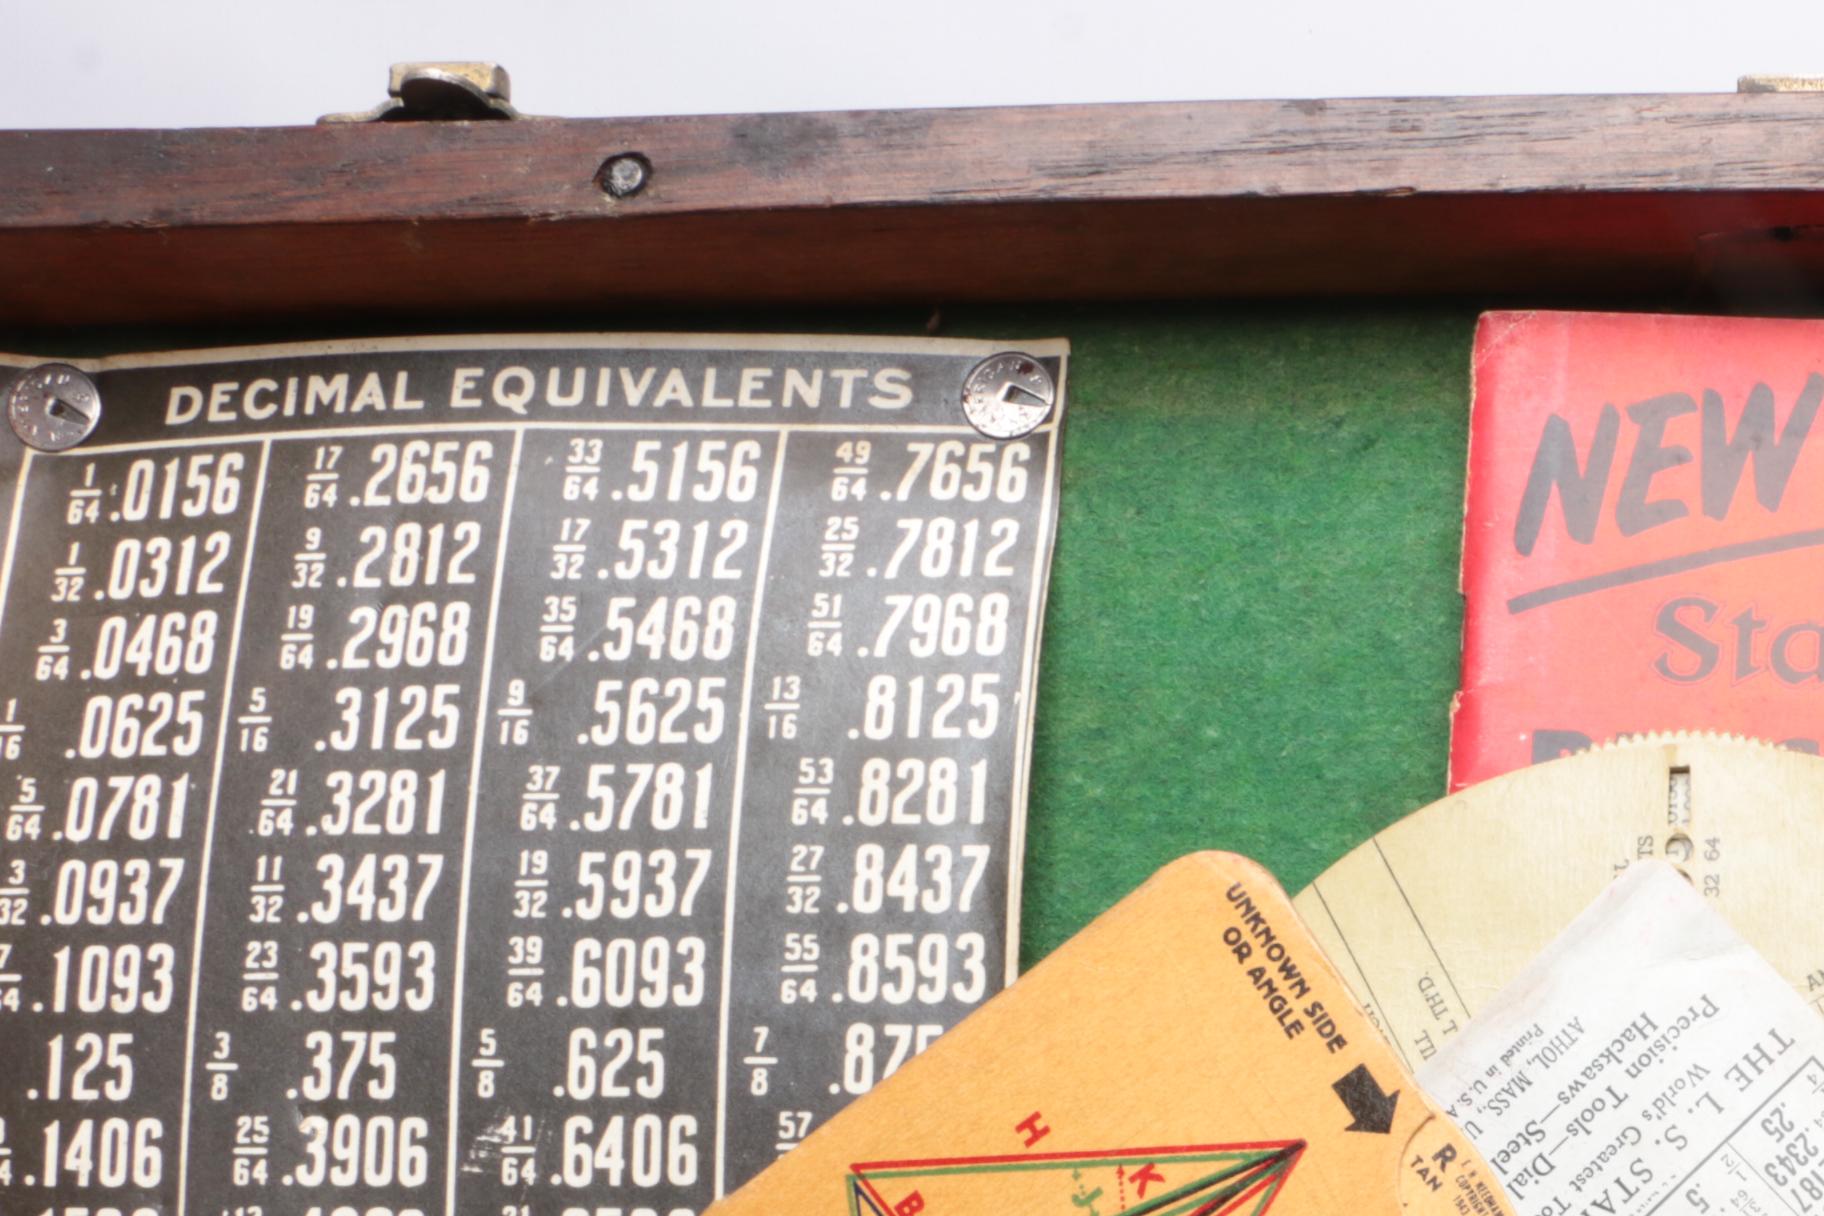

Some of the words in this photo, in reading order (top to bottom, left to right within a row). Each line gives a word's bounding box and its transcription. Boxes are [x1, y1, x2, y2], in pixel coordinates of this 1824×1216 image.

[165, 371, 423, 426] DECIMAL
[451, 366, 914, 414] EQUIVALENTS
[111, 453, 243, 521] .0156
[350, 441, 493, 506] .2656
[611, 441, 760, 501] .5156
[880, 441, 1030, 501] .7656
[95, 531, 230, 600] .0312
[597, 519, 748, 580] .5312
[81, 610, 217, 679] .0468
[326, 601, 471, 669] .2968
[588, 594, 735, 662] .5468
[857, 593, 1009, 657] .7968
[315, 684, 460, 751] .3125
[848, 674, 1000, 739] .8125
[53, 773, 188, 842] .0781
[569, 762, 713, 832] .5781
[41, 858, 184, 925] .0937
[297, 854, 443, 923] .3437
[836, 844, 991, 914] .8437
[33, 943, 174, 1013] .1093
[291, 941, 435, 1012] .3593
[557, 936, 706, 1008] .6093
[832, 931, 986, 1005] .8593
[1223, 927, 1252, 964] OR
[1246, 967, 1305, 1040] ANGLE
[1226, 883, 1311, 1000] UNKNOWN
[1303, 1001, 1348, 1054] SIDE
[28, 1033, 132, 1100] .125
[287, 1031, 395, 1101] .375
[554, 1028, 664, 1100] .625
[1499, 1023, 1544, 1067] Printed
[1526, 1016, 1585, 1070] ATHOL,
[1624, 994, 1720, 1079] Precision
[1723, 1028, 1796, 1092] THE
[1641, 1063, 1711, 1122] World's
[25, 1118, 162, 1188] .1406
[550, 1114, 697, 1188] .6406
[1015, 1111, 1050, 1148] H
[1432, 1143, 1457, 1173] R
[1569, 1126, 1642, 1193] Greatest
[1410, 1155, 1443, 1192] TAN
